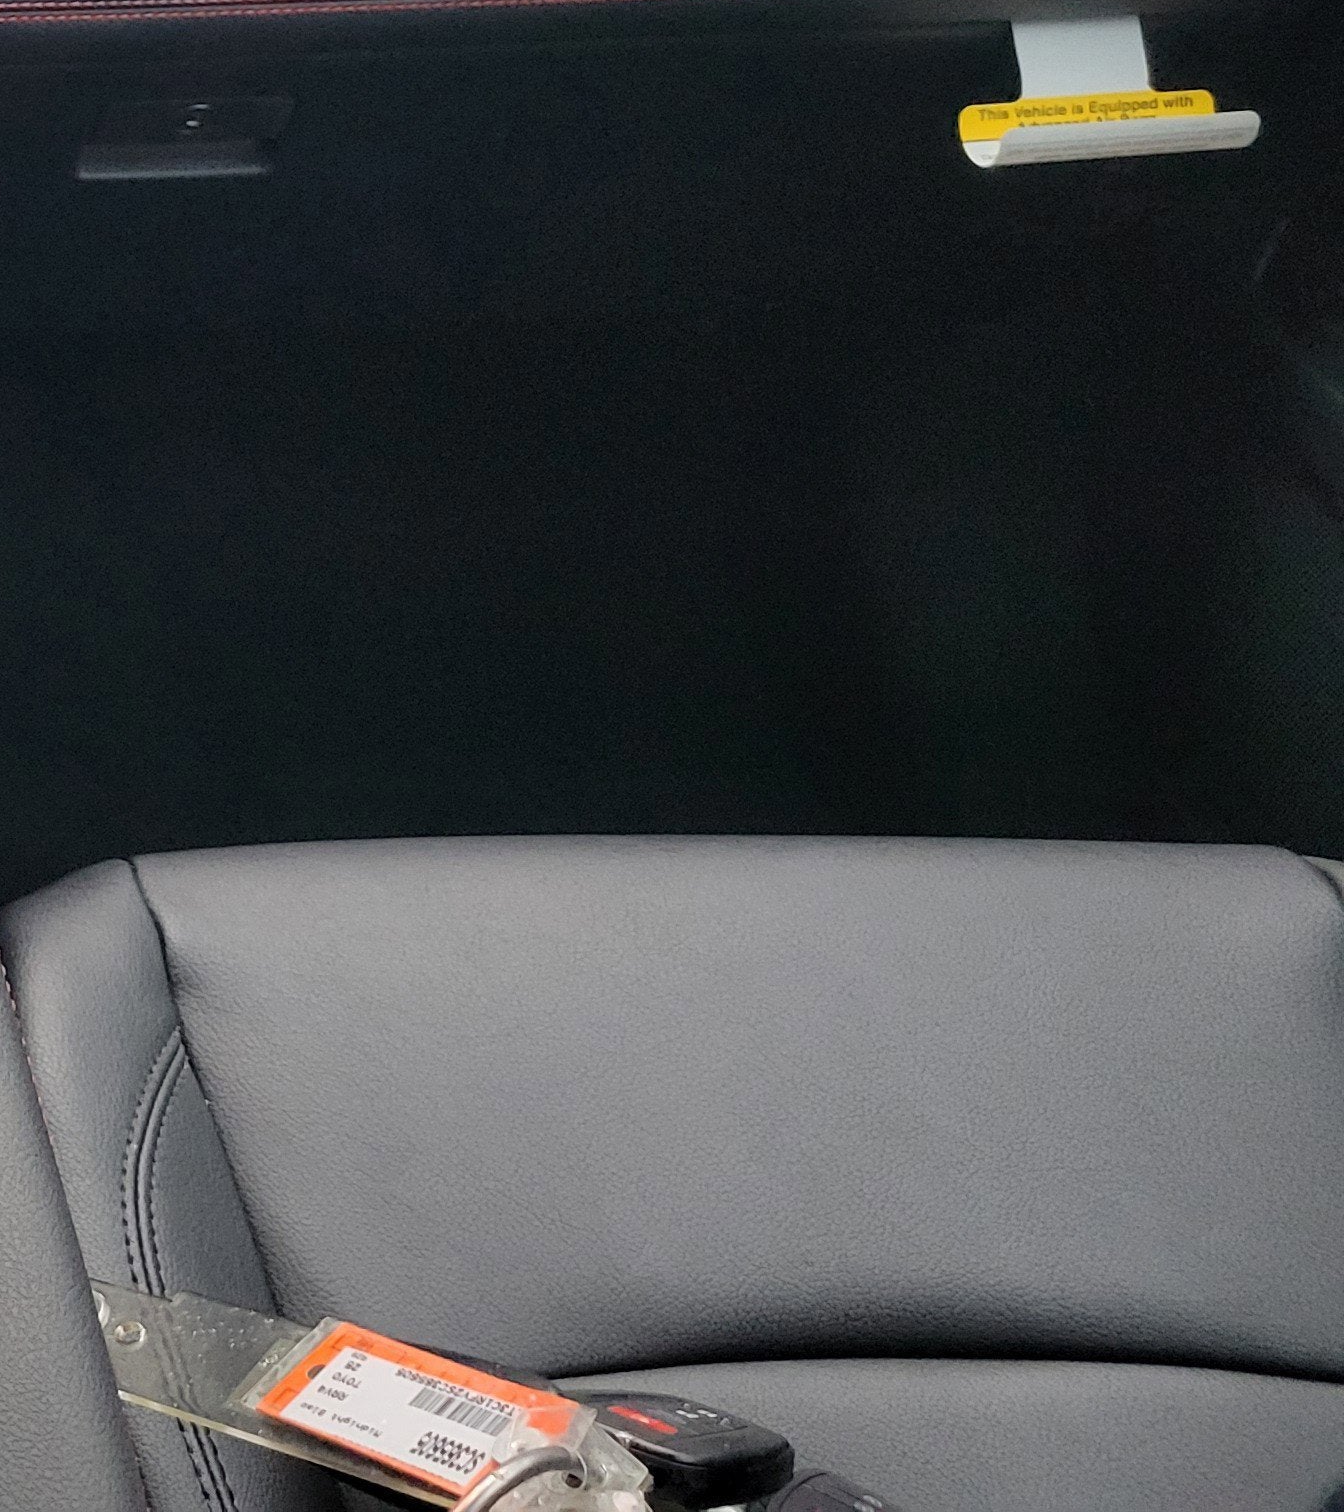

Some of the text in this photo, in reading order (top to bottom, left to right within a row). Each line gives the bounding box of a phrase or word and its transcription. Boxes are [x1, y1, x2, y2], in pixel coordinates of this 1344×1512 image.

[977, 109, 1010, 121] This
[1014, 103, 1067, 118] Vehicle
[1088, 97, 1159, 115] Equipped
[1162, 96, 1193, 108] with
